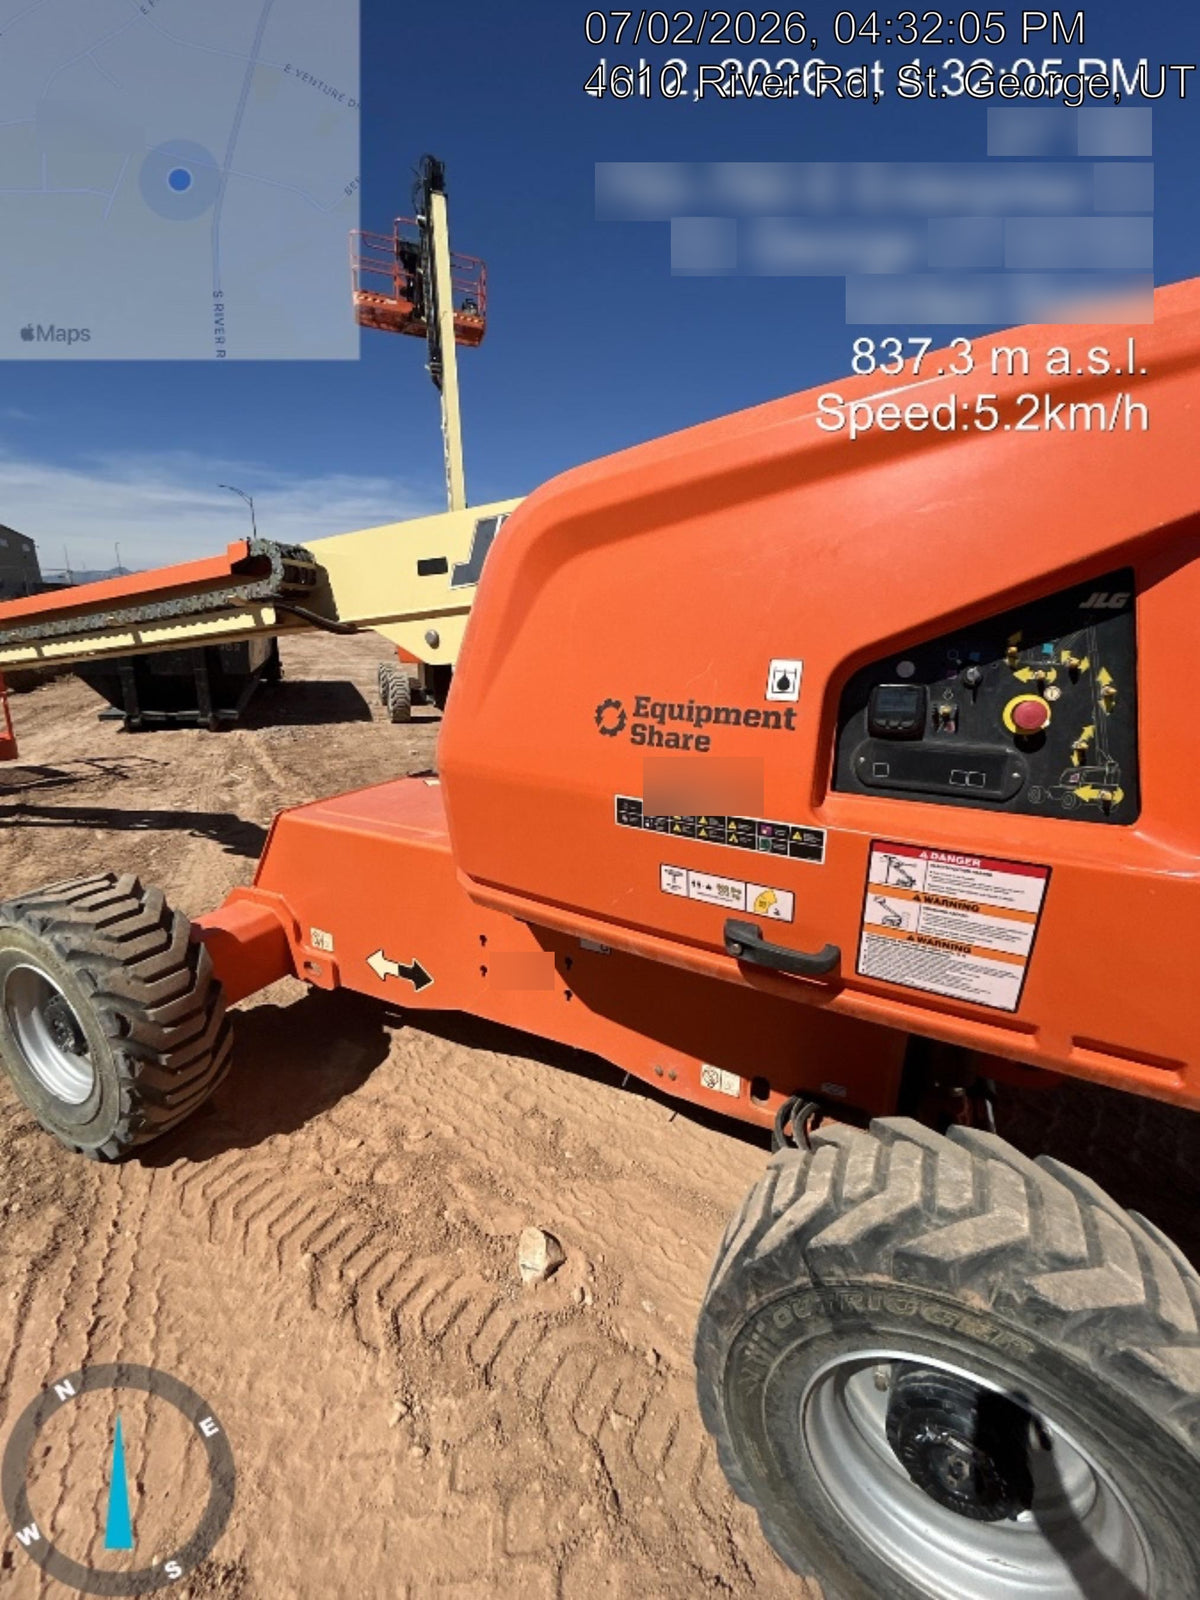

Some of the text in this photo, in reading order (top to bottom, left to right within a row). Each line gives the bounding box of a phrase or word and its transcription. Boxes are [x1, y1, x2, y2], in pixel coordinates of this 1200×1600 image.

[1078, 592, 1132, 609] JLG
[632, 695, 798, 731] Equipment
[629, 722, 711, 752] Share
[929, 851, 981, 868] DANGER
[923, 894, 981, 914] WARNING
[916, 935, 972, 955] WARNING
